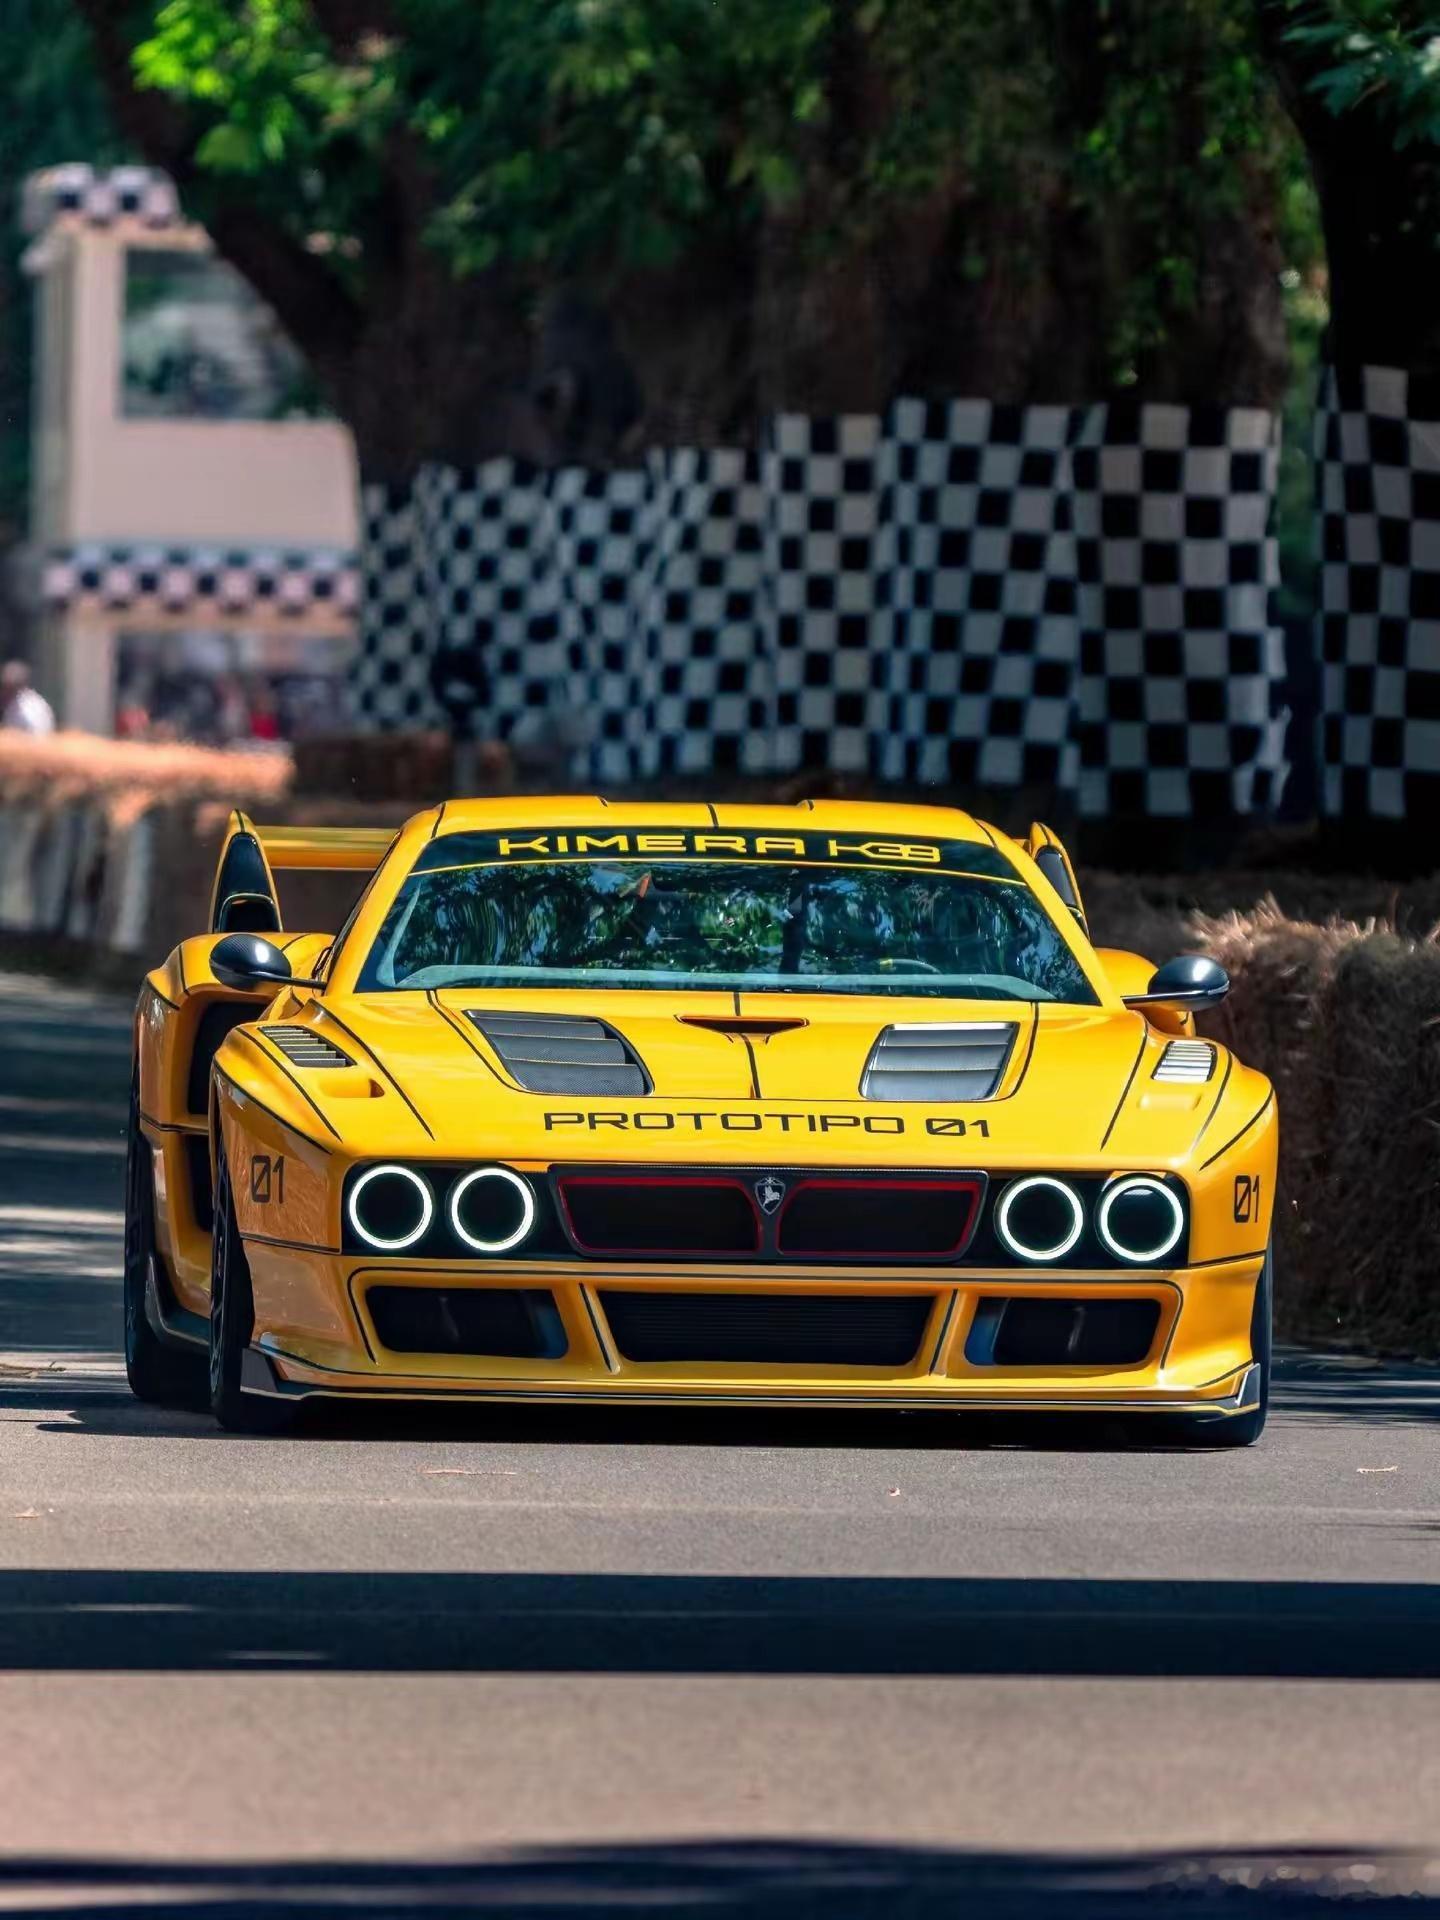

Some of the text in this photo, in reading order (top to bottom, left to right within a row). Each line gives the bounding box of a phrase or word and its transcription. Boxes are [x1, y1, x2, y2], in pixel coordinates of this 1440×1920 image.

[499, 835, 940, 862] KIMERA K39
[544, 1112, 990, 1138] PROTOTIPO 01
[251, 1155, 285, 1204] 01
[1234, 1175, 1259, 1223] 01
